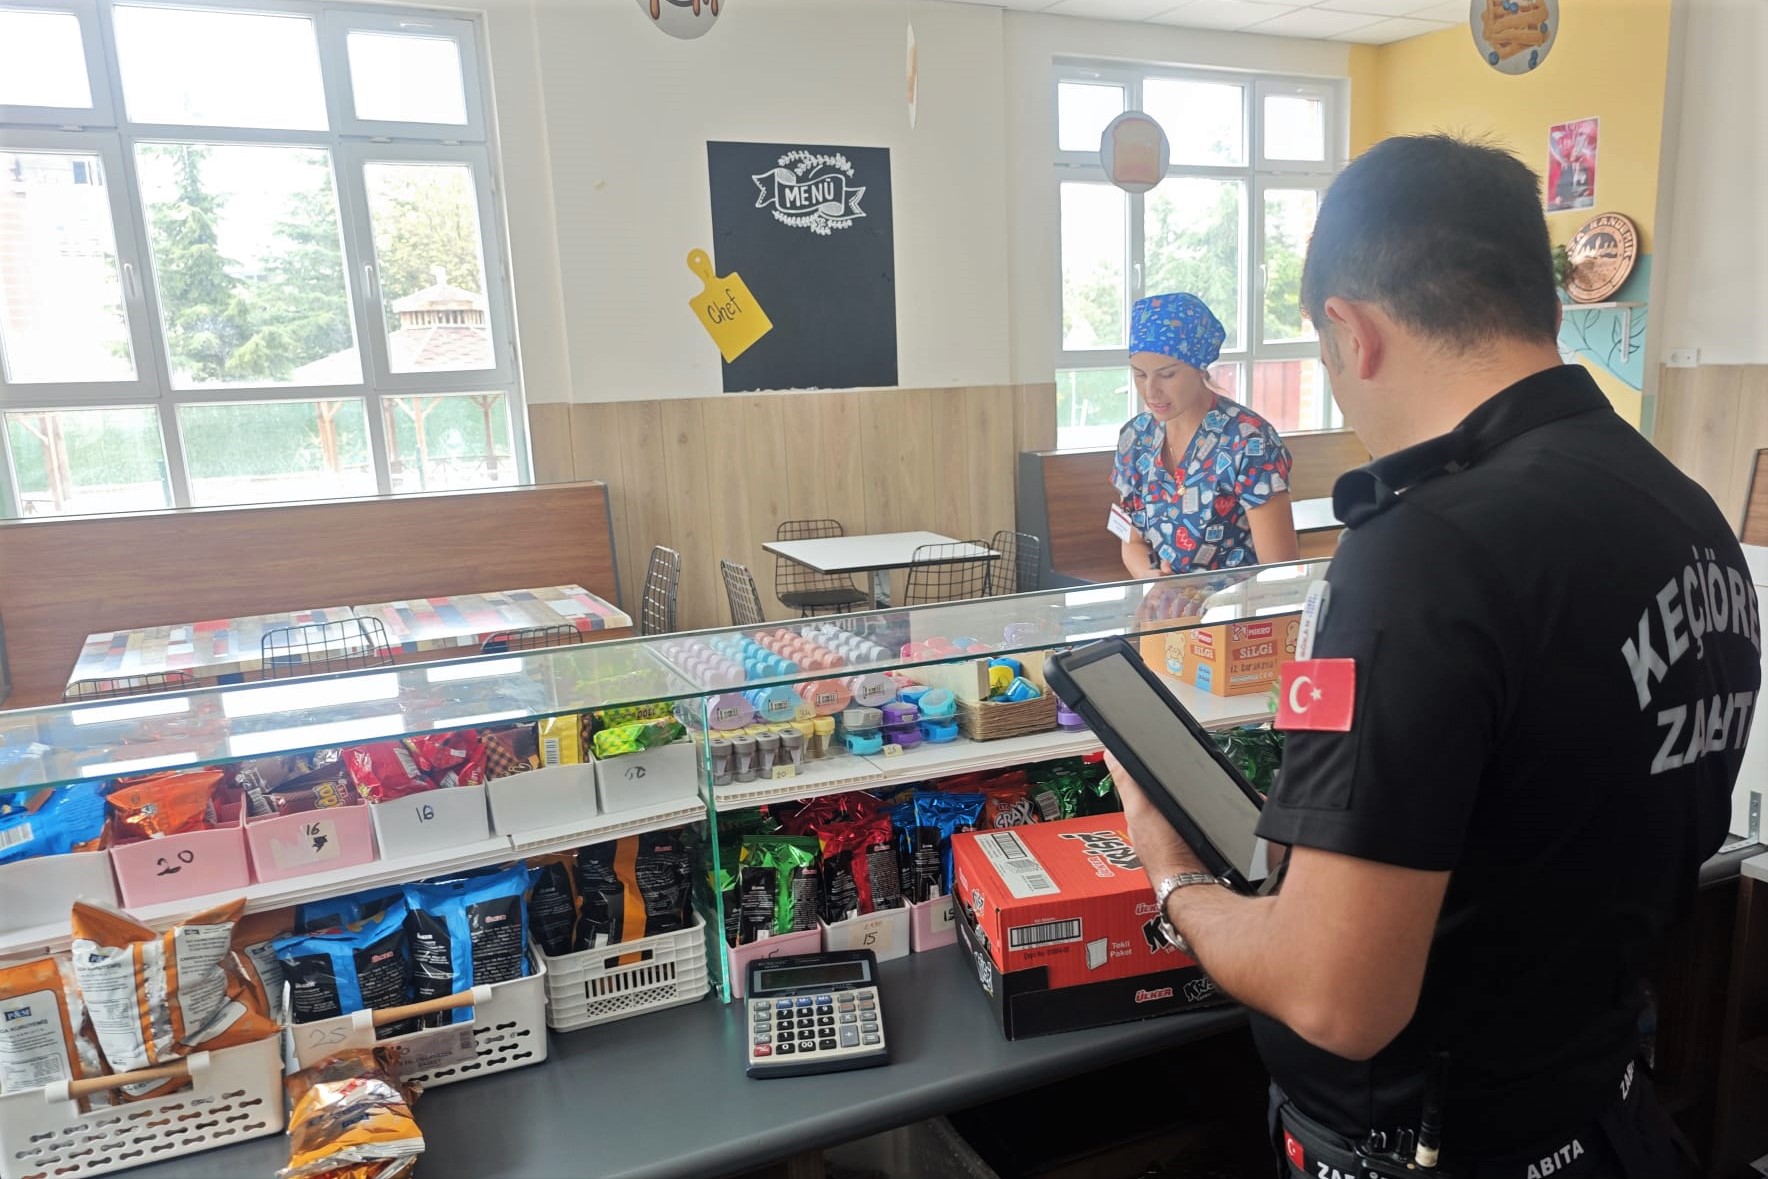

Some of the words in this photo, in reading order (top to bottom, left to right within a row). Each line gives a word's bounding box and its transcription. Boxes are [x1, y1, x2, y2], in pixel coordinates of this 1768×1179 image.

[784, 178, 835, 207] MENÜ
[707, 288, 742, 324] Chef
[1621, 545, 1761, 711] KEÇİÖRE
[1650, 689, 1760, 775] ZABIT
[306, 822, 321, 836] 16
[157, 850, 194, 876] 20
[863, 931, 878, 945] 15
[1110, 949, 1132, 958] Paket
[1135, 988, 1173, 1003] ÜLKER
